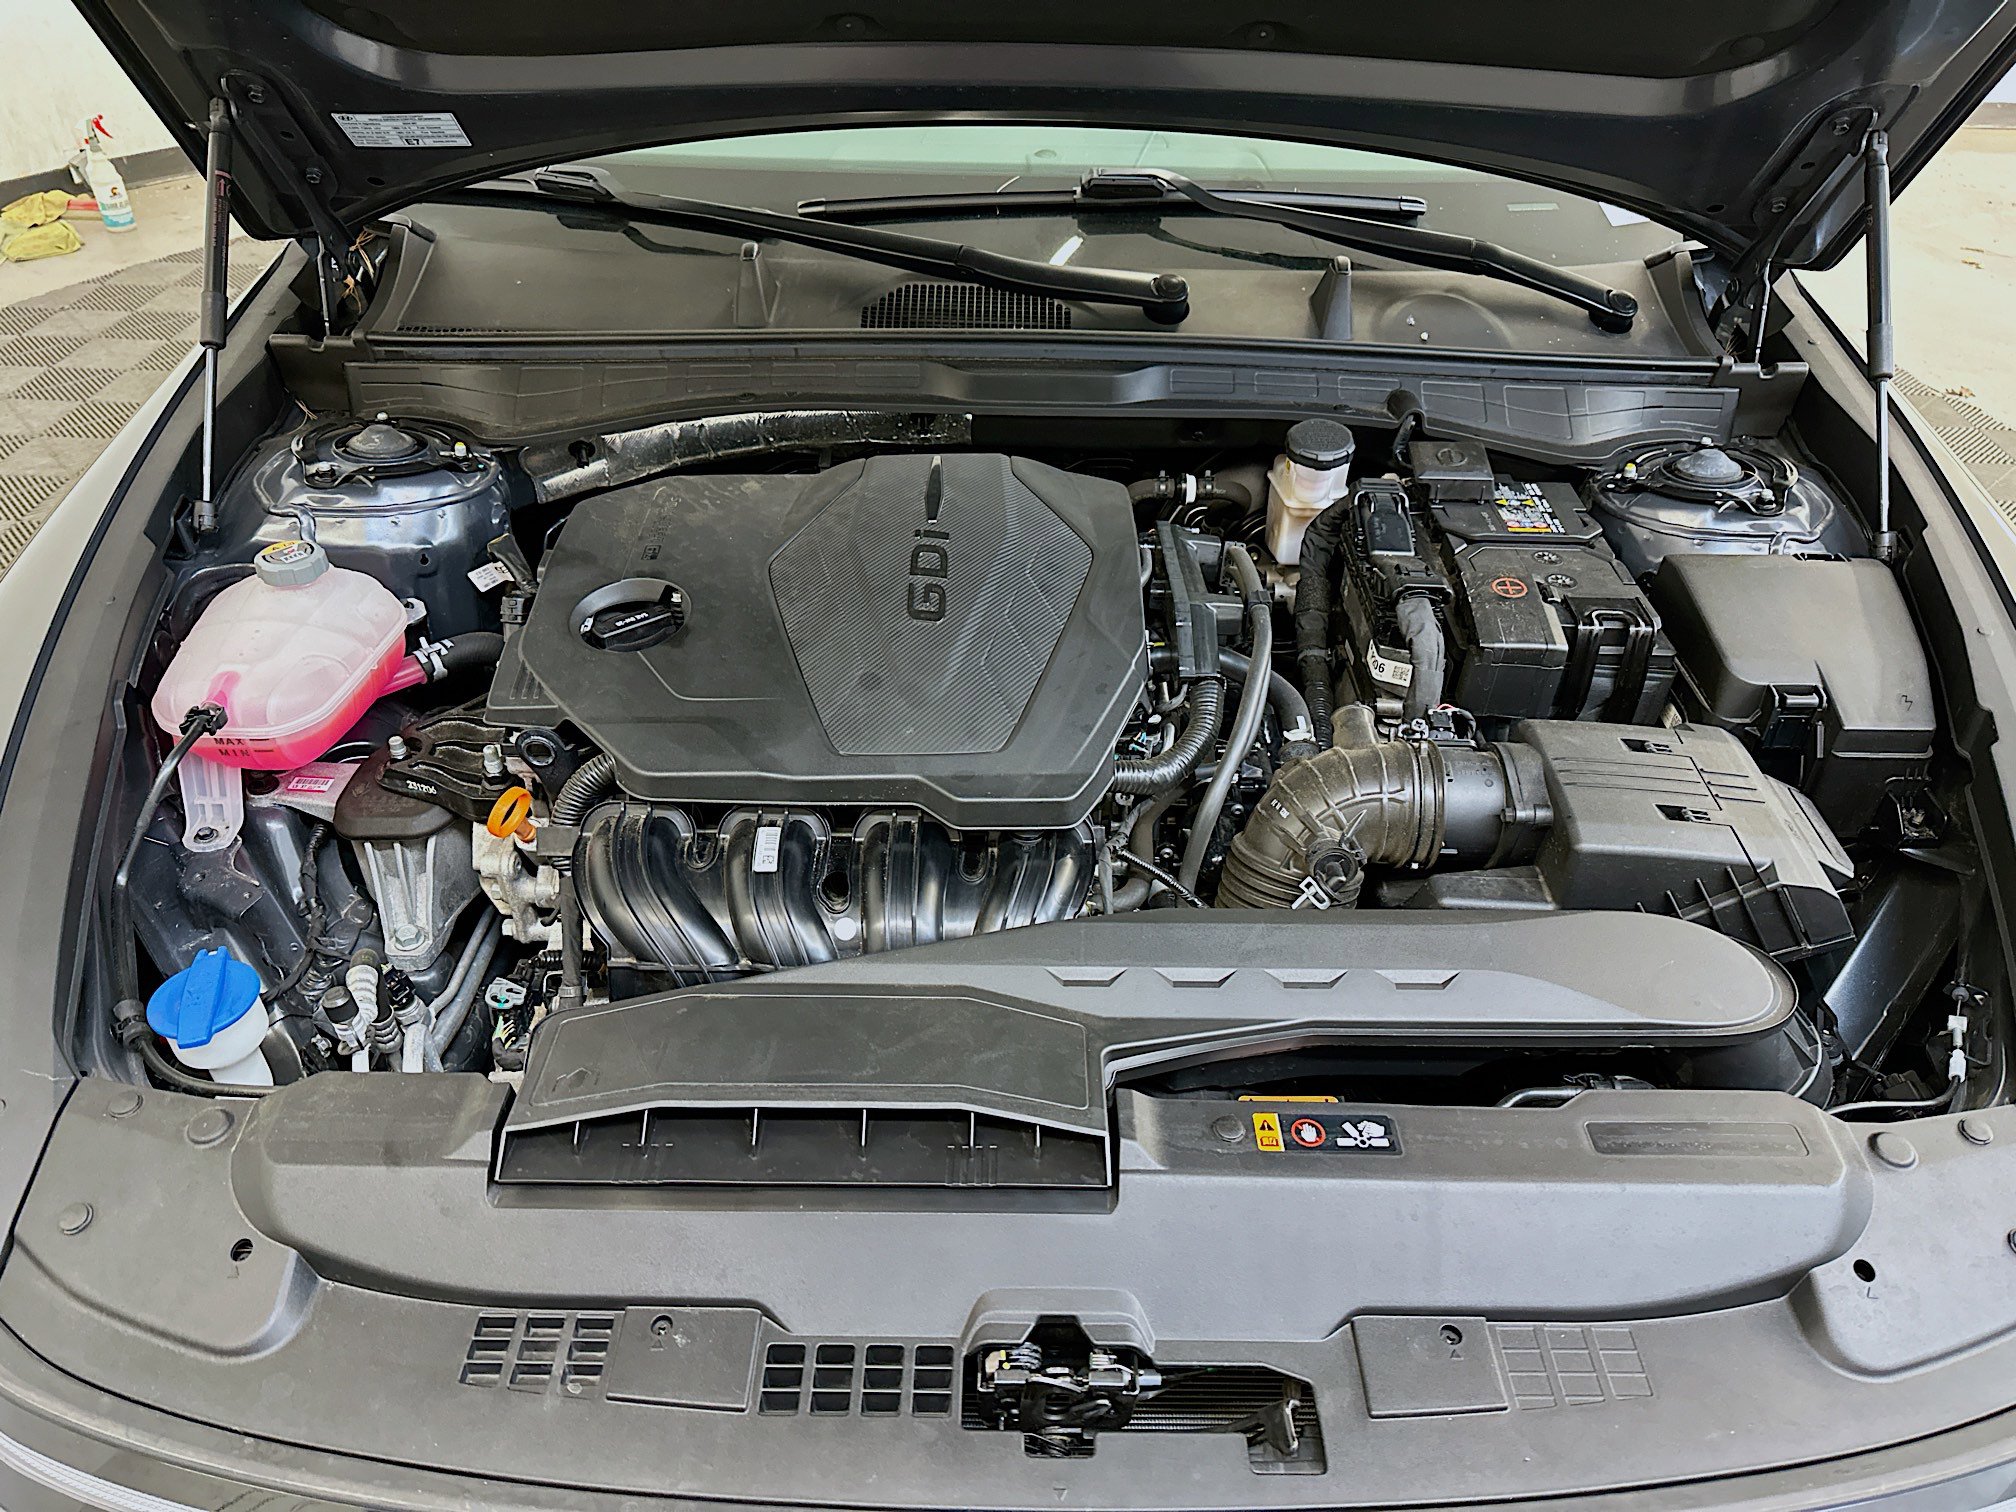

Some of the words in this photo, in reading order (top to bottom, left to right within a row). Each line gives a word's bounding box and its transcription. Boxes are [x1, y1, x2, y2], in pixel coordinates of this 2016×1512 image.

[907, 529, 950, 622] GDi
[213, 737, 245, 746] MAX
[218, 748, 250, 757] MIN
[406, 780, 437, 794] 231206
